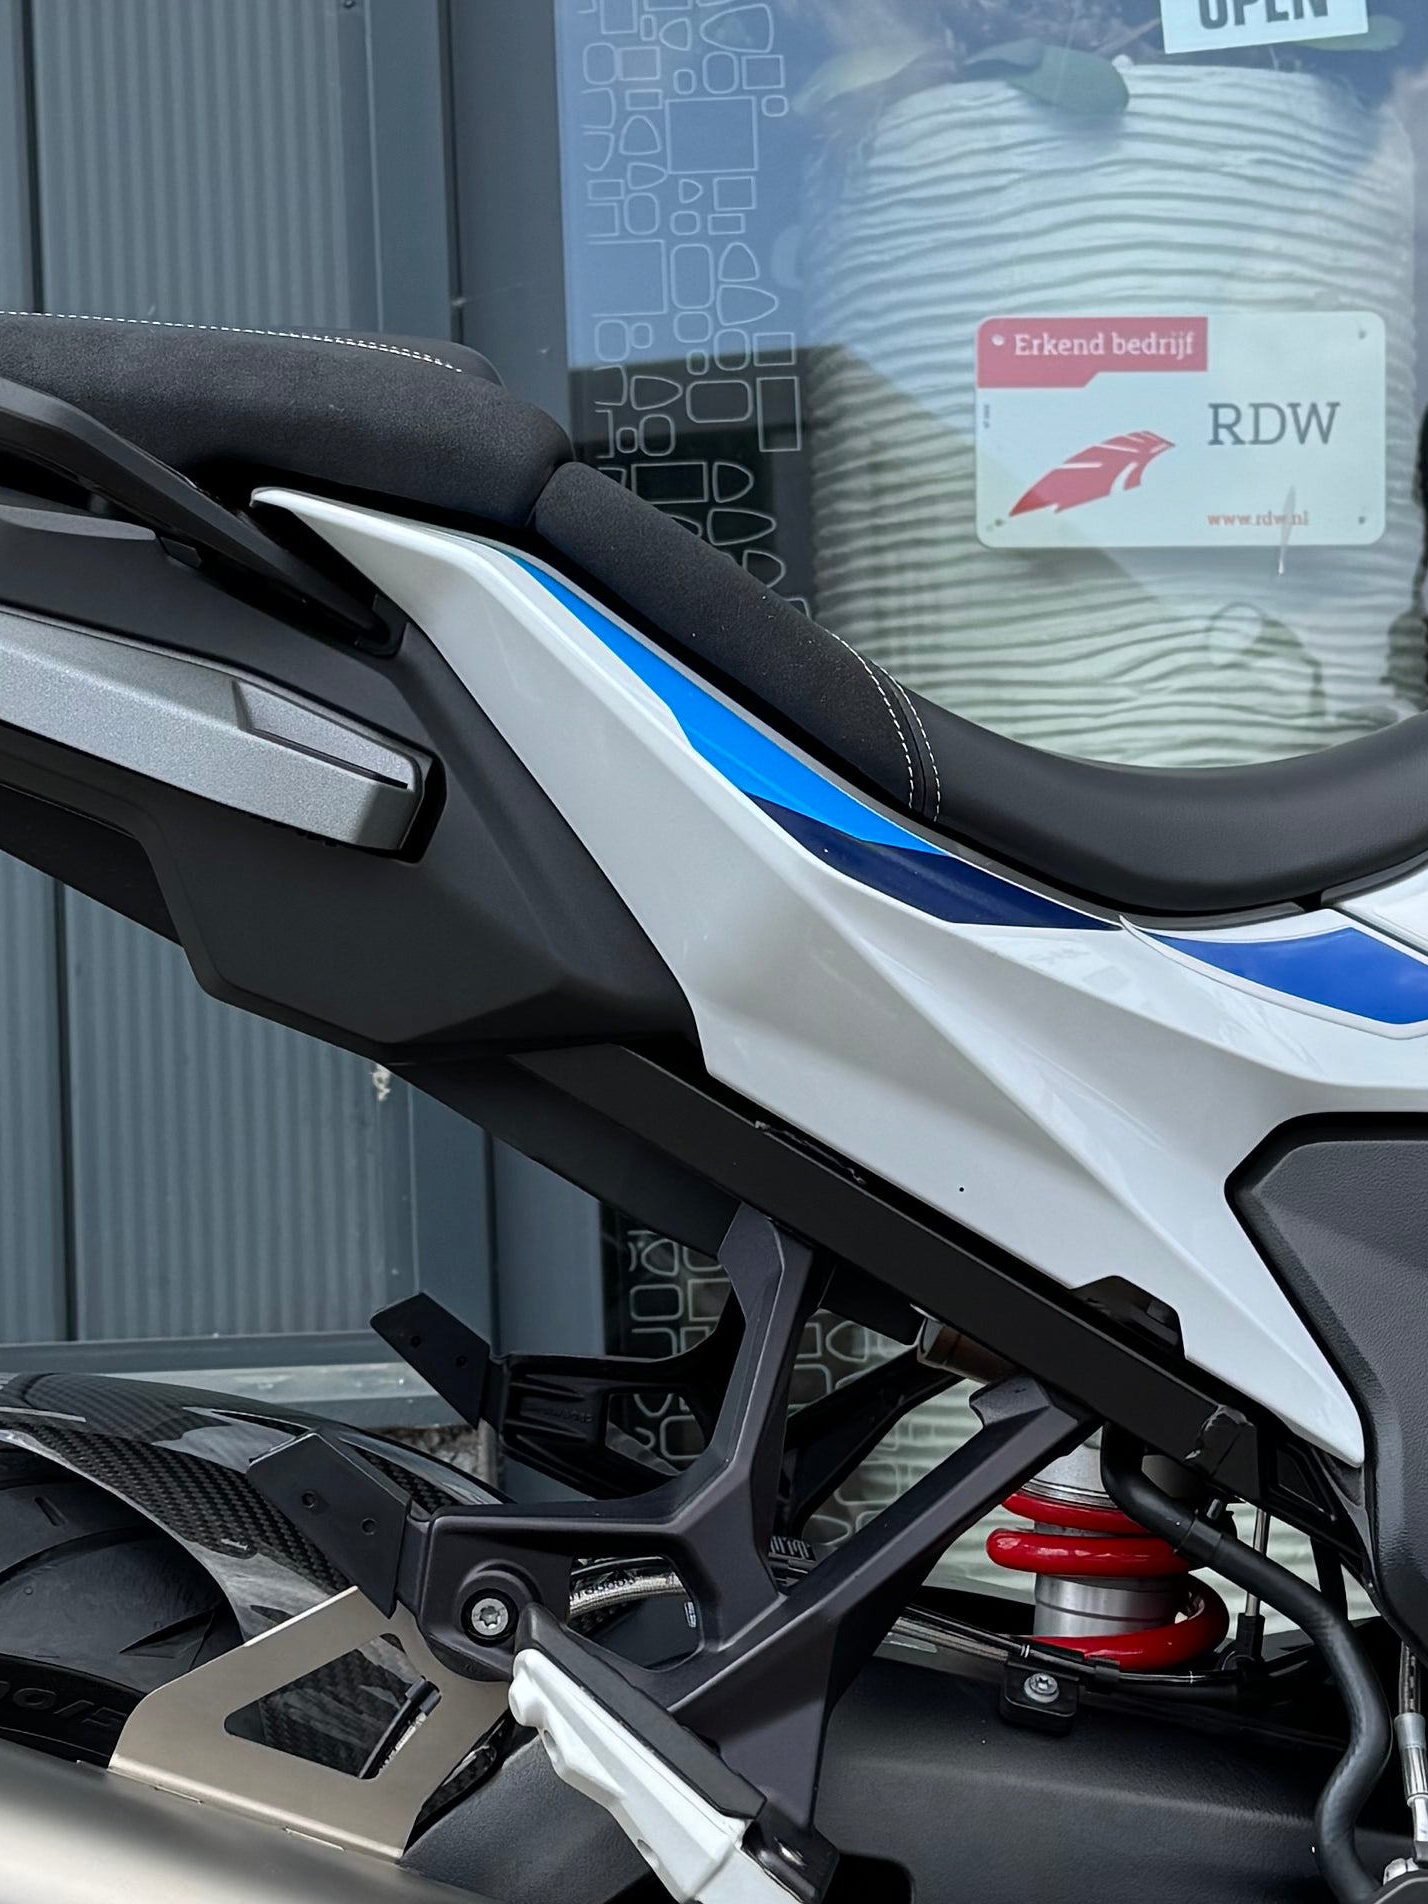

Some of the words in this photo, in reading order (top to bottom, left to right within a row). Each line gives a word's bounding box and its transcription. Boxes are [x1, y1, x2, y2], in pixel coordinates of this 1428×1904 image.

[1014, 332, 1105, 357] Erkend
[1112, 331, 1195, 358] bedrijf
[1207, 401, 1341, 447] RDW
[1207, 509, 1310, 527] www.rdwnl
